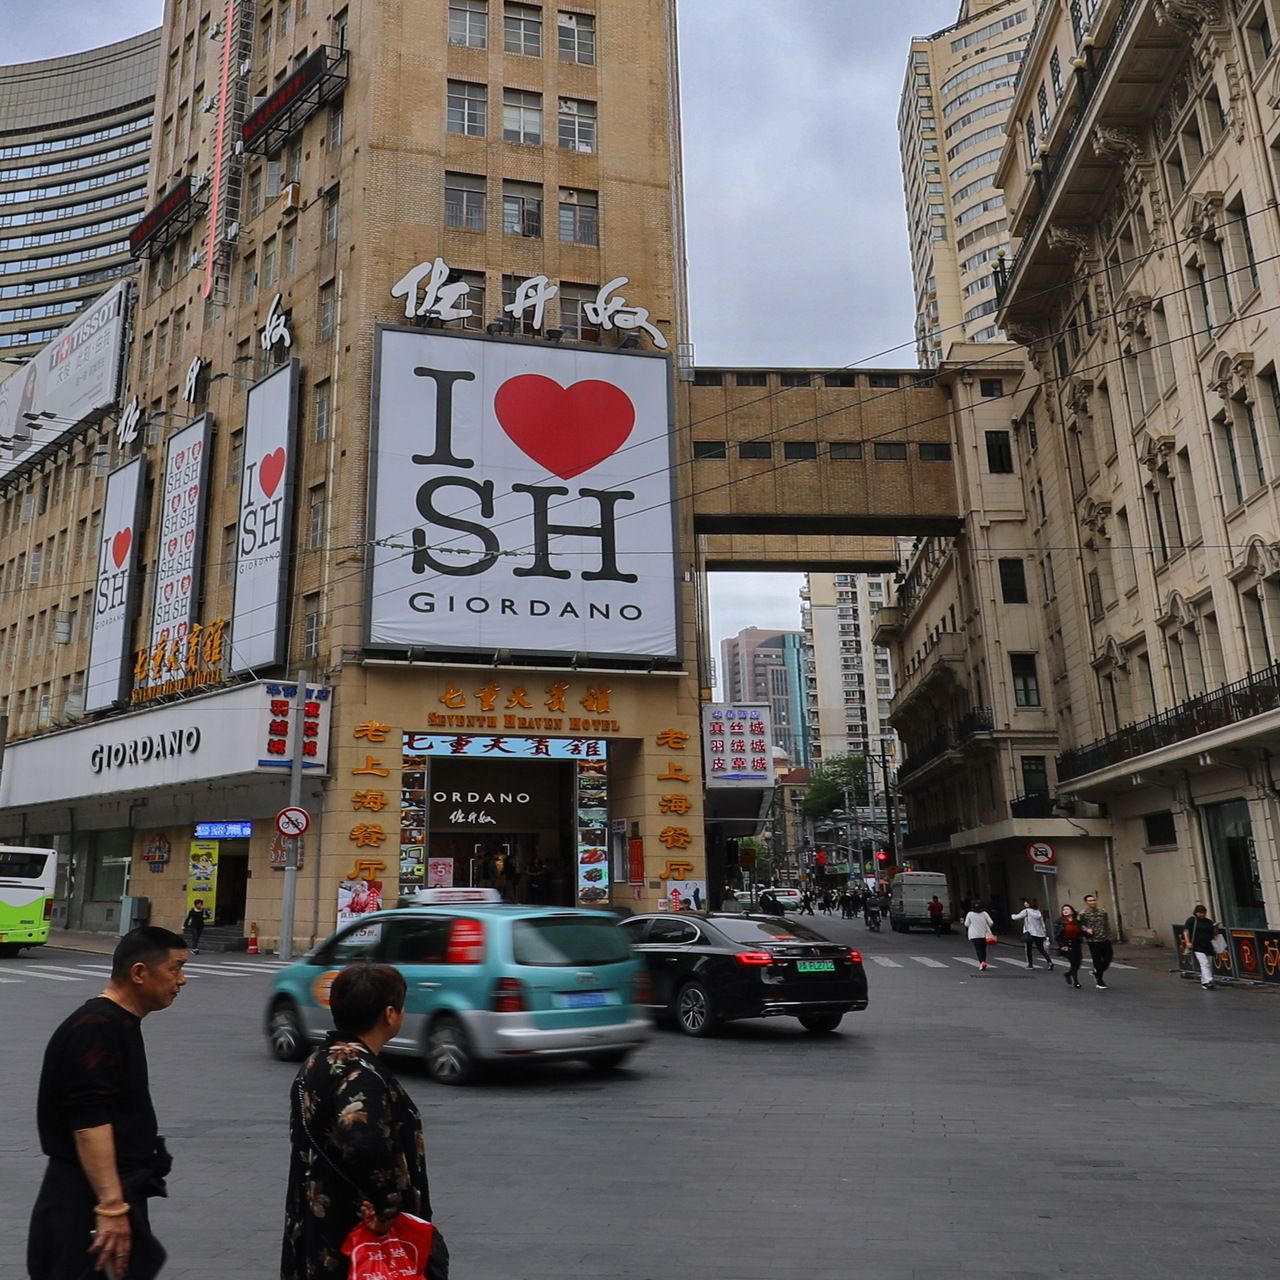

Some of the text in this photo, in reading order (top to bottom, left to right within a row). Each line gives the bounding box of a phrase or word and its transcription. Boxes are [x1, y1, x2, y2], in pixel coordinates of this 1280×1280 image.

[72, 298, 117, 350] TISSOT
[411, 366, 476, 469] I
[244, 463, 256, 509] I
[240, 497, 281, 558] SH
[411, 475, 639, 584] SH
[101, 537, 111, 575] I
[239, 551, 281, 575] GIORDANO
[97, 570, 128, 616] SH
[408, 591, 642, 621] GIORDANO
[569, 717, 620, 732] HOTEL
[710, 721, 765, 735] 真丝城
[711, 739, 766, 753] 羽绒城
[90, 726, 201, 773] GIORDANO
[347, 720, 391, 881] 老上海餐厅
[656, 728, 695, 881] 老上海餐厅
